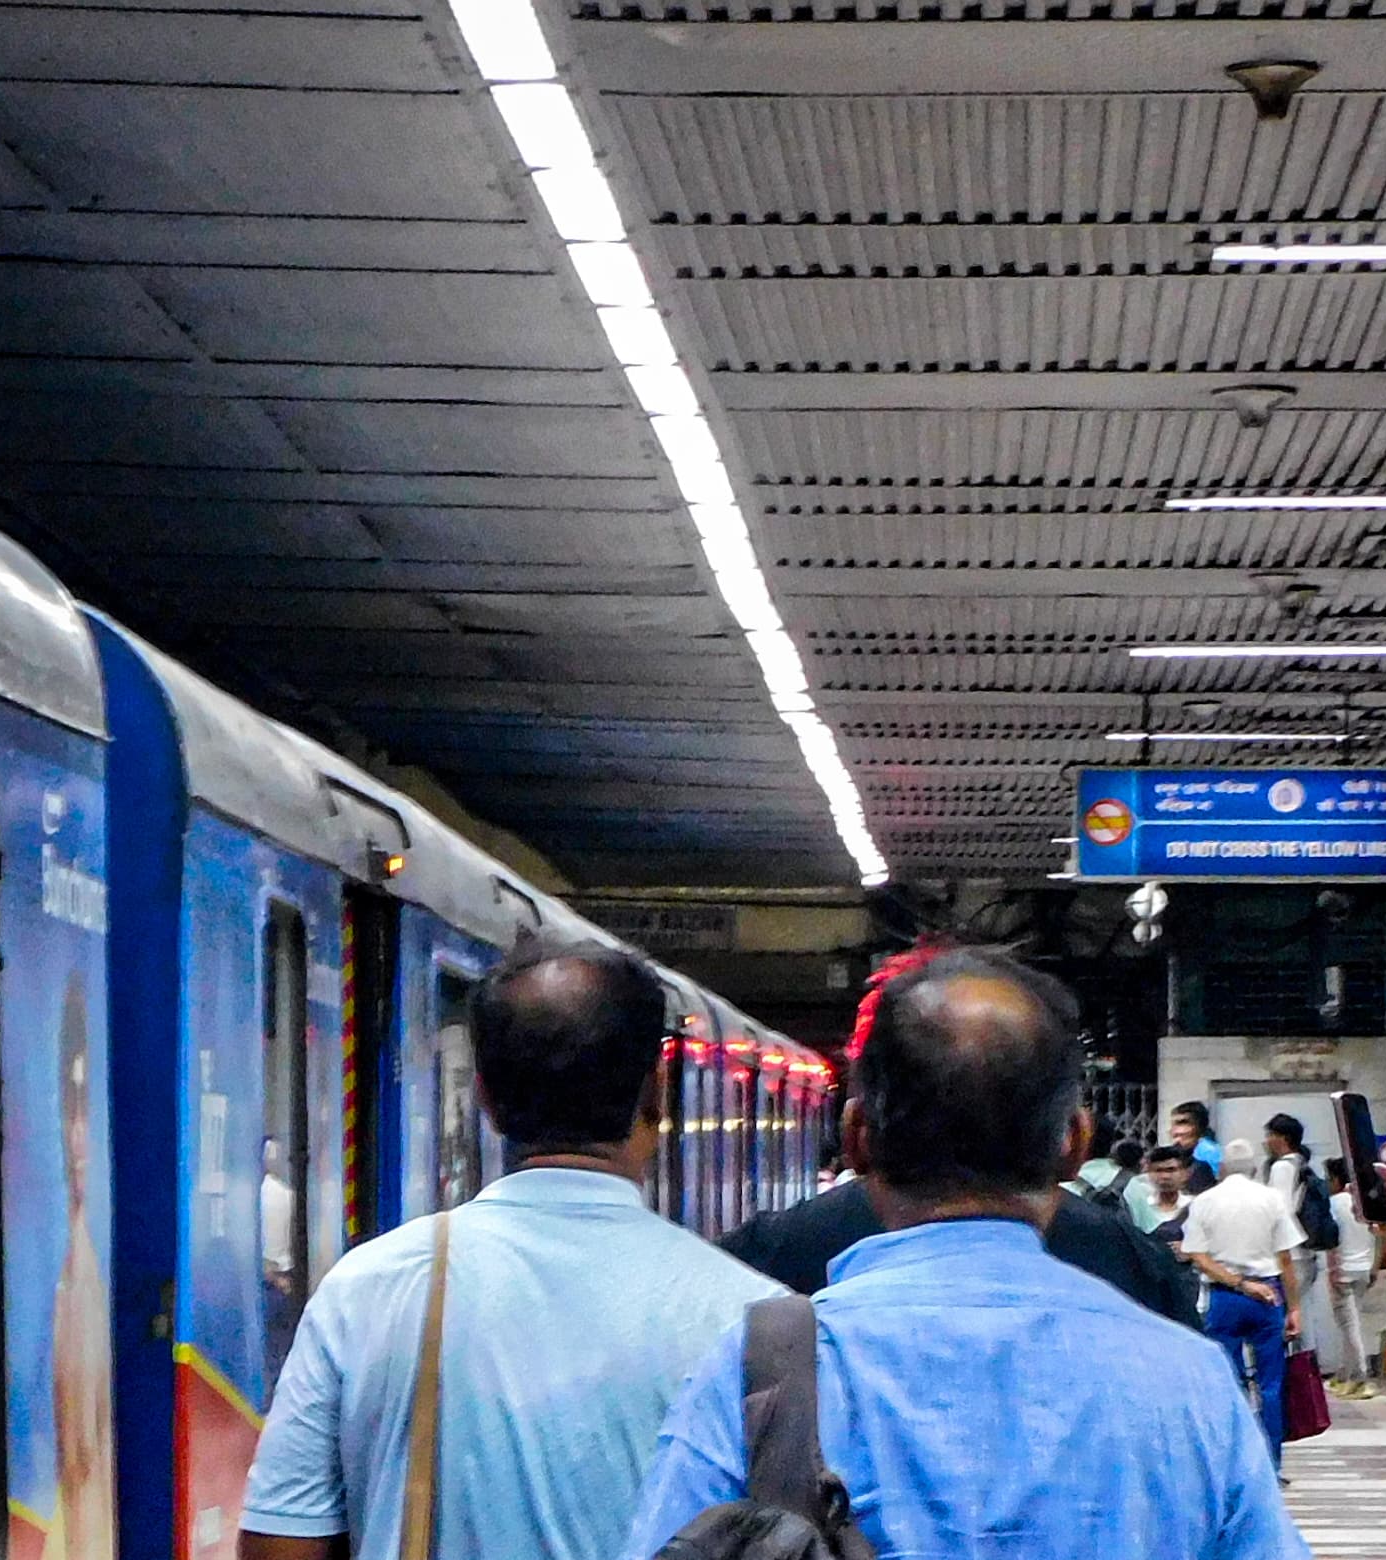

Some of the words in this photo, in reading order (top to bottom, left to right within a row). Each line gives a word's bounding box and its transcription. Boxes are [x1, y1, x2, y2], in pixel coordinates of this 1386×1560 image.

[1219, 841, 1269, 858] CROSS
[1270, 841, 1301, 858] THE
[1301, 841, 1358, 858] YELLOW
